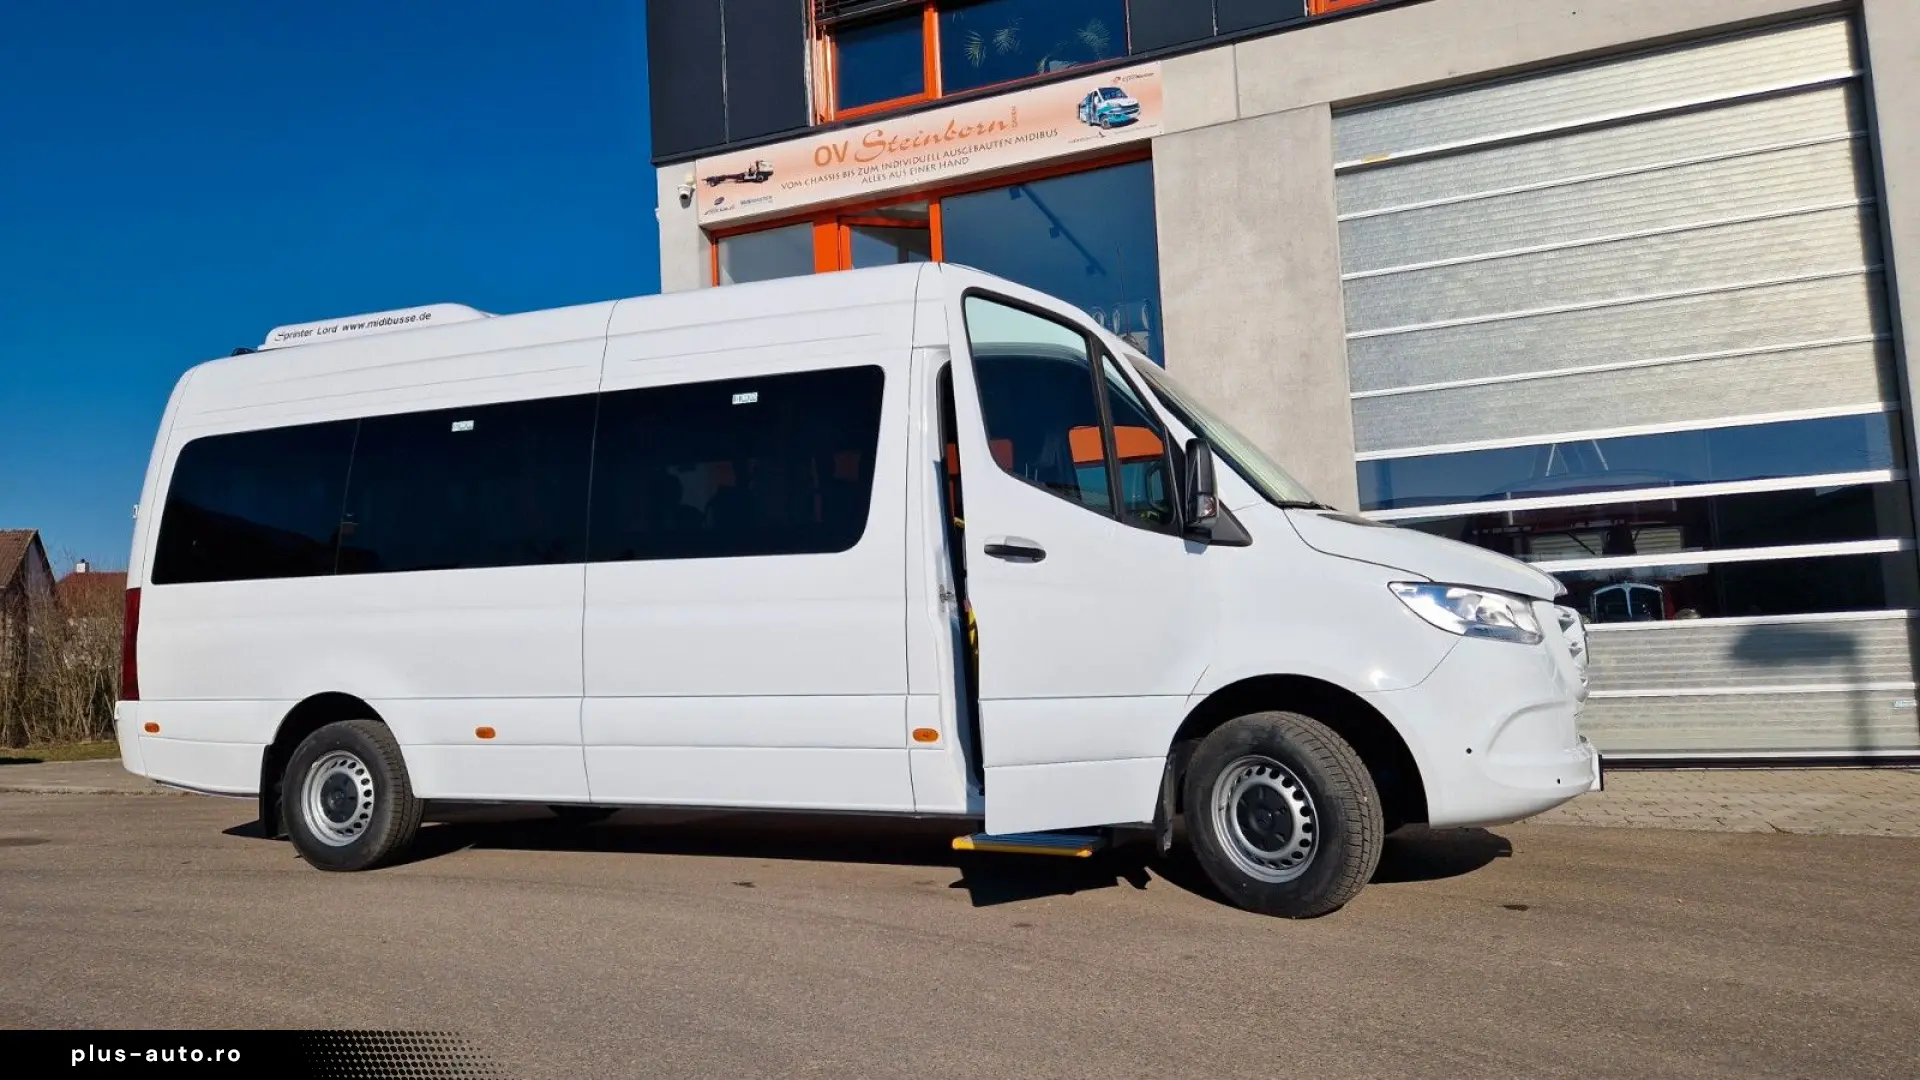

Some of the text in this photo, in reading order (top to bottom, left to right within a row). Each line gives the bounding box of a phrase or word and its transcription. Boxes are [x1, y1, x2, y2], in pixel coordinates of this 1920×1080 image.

[780, 179, 803, 190] VOM
[804, 172, 840, 186] CHASSIS
[841, 169, 856, 179] BIS
[857, 165, 879, 176] ZUM
[1014, 128, 1059, 145] MIDIBUS
[814, 140, 849, 167] OV
[854, 118, 1008, 163] Steinborn
[861, 156, 970, 185] ALLES AUS EINER HAND
[274, 311, 432, 342] Sprinter Lord www.midibusse.de
